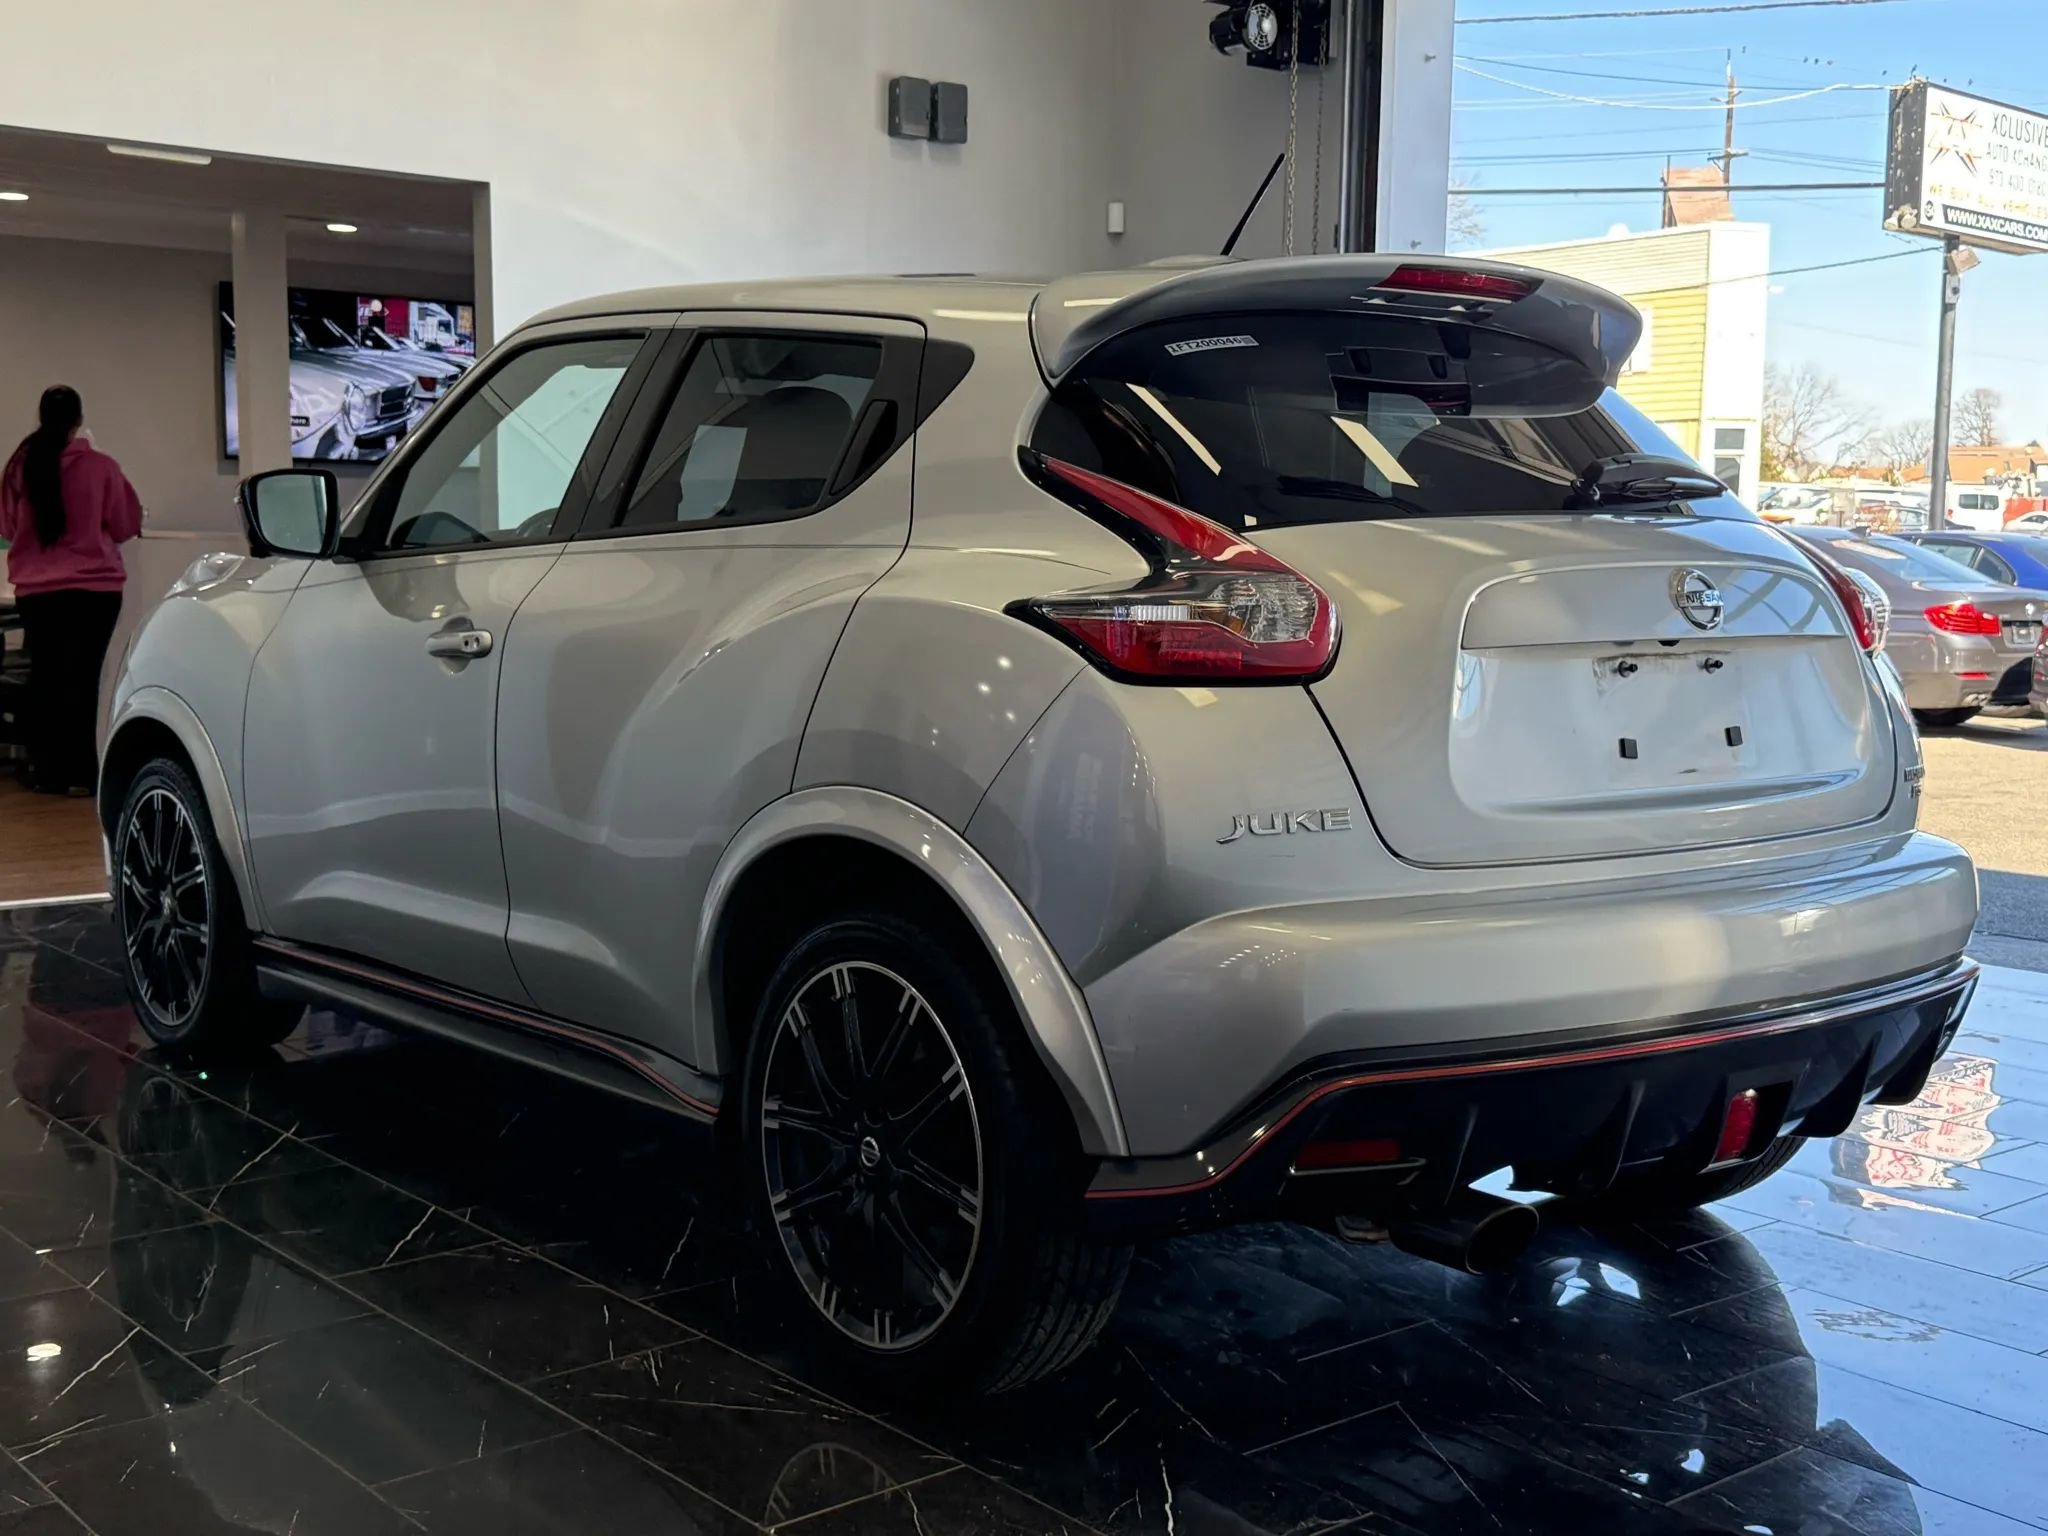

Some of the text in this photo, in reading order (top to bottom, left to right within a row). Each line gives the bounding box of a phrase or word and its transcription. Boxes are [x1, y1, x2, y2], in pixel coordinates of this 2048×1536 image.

[1992, 111, 2048, 148] XCLUSIVE
[1986, 142, 2008, 163] AUTO
[1946, 207, 2048, 241] WWW.XAXCARS.COM
[1216, 807, 1352, 844] JUKE
